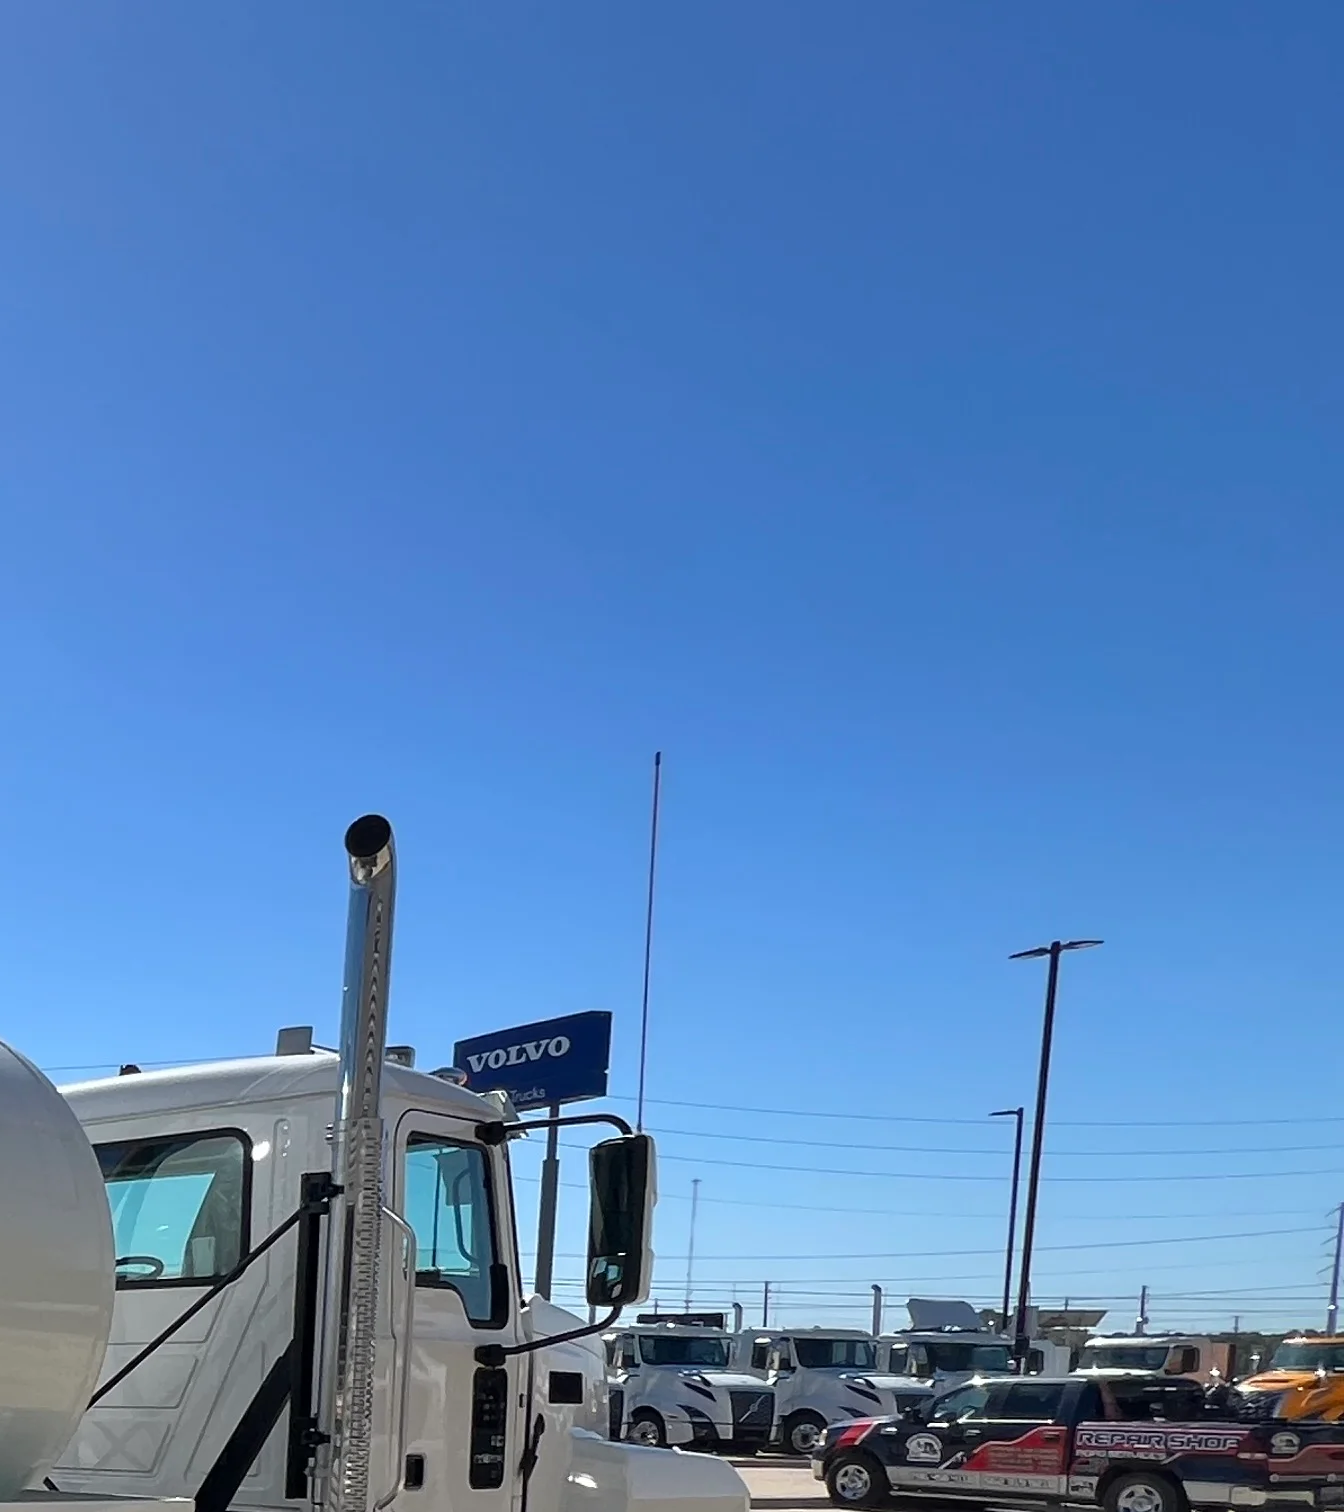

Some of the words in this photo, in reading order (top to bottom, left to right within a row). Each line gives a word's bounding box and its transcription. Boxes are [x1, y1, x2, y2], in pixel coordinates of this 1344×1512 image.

[466, 1035, 571, 1074] VOLVO
[510, 1086, 546, 1102] Trucks
[1076, 1431, 1166, 1447] REPAIR
